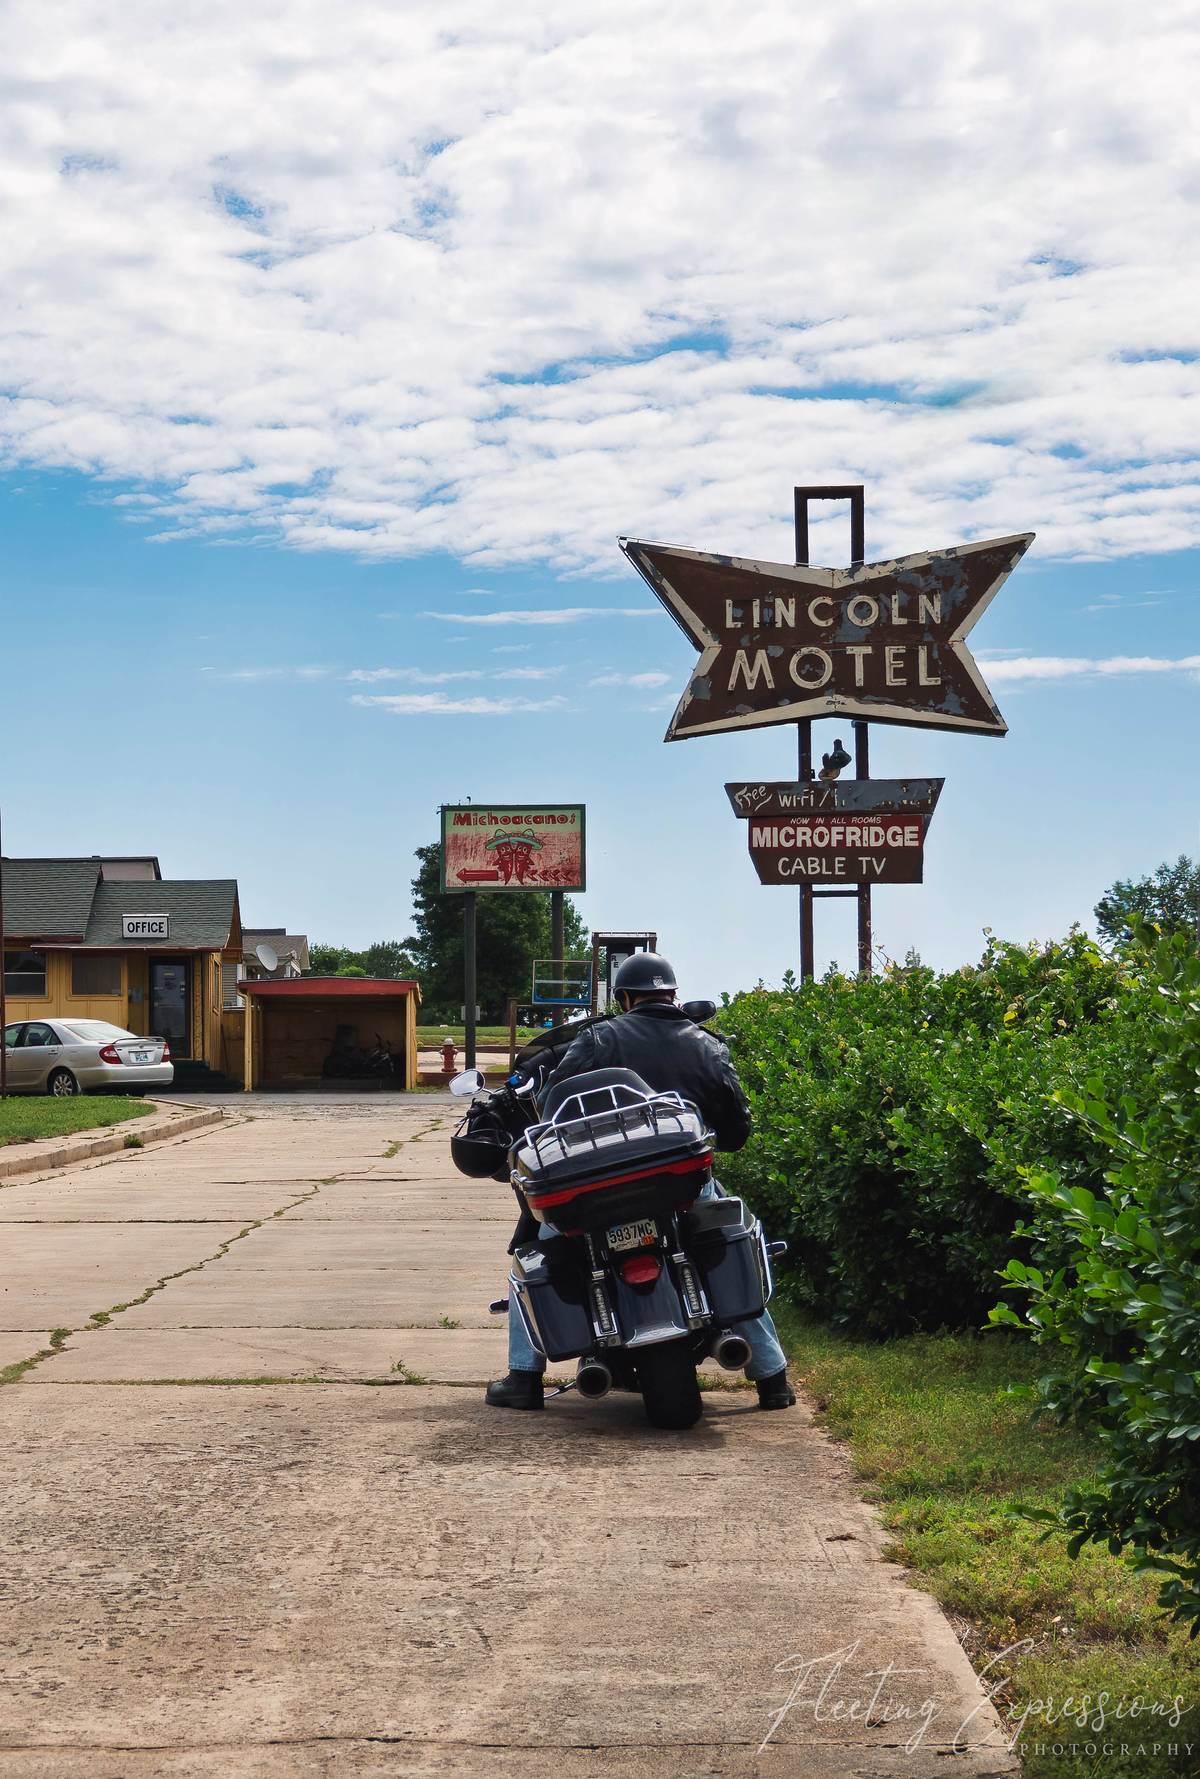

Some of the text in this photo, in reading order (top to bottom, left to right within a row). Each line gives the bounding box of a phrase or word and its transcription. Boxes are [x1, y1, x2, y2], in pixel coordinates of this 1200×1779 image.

[725, 595, 941, 628] LINCOLN
[728, 646, 942, 691] MOTEL
[734, 786, 769, 809] Free
[453, 812, 576, 826] Michoacanos
[790, 817, 810, 825] NOW
[830, 816, 847, 824] ALL
[851, 816, 882, 824] ROOMS
[752, 826, 920, 848] MICROFRIDGE
[777, 857, 886, 876] CABLE TV
[127, 921, 165, 933] OFFICE
